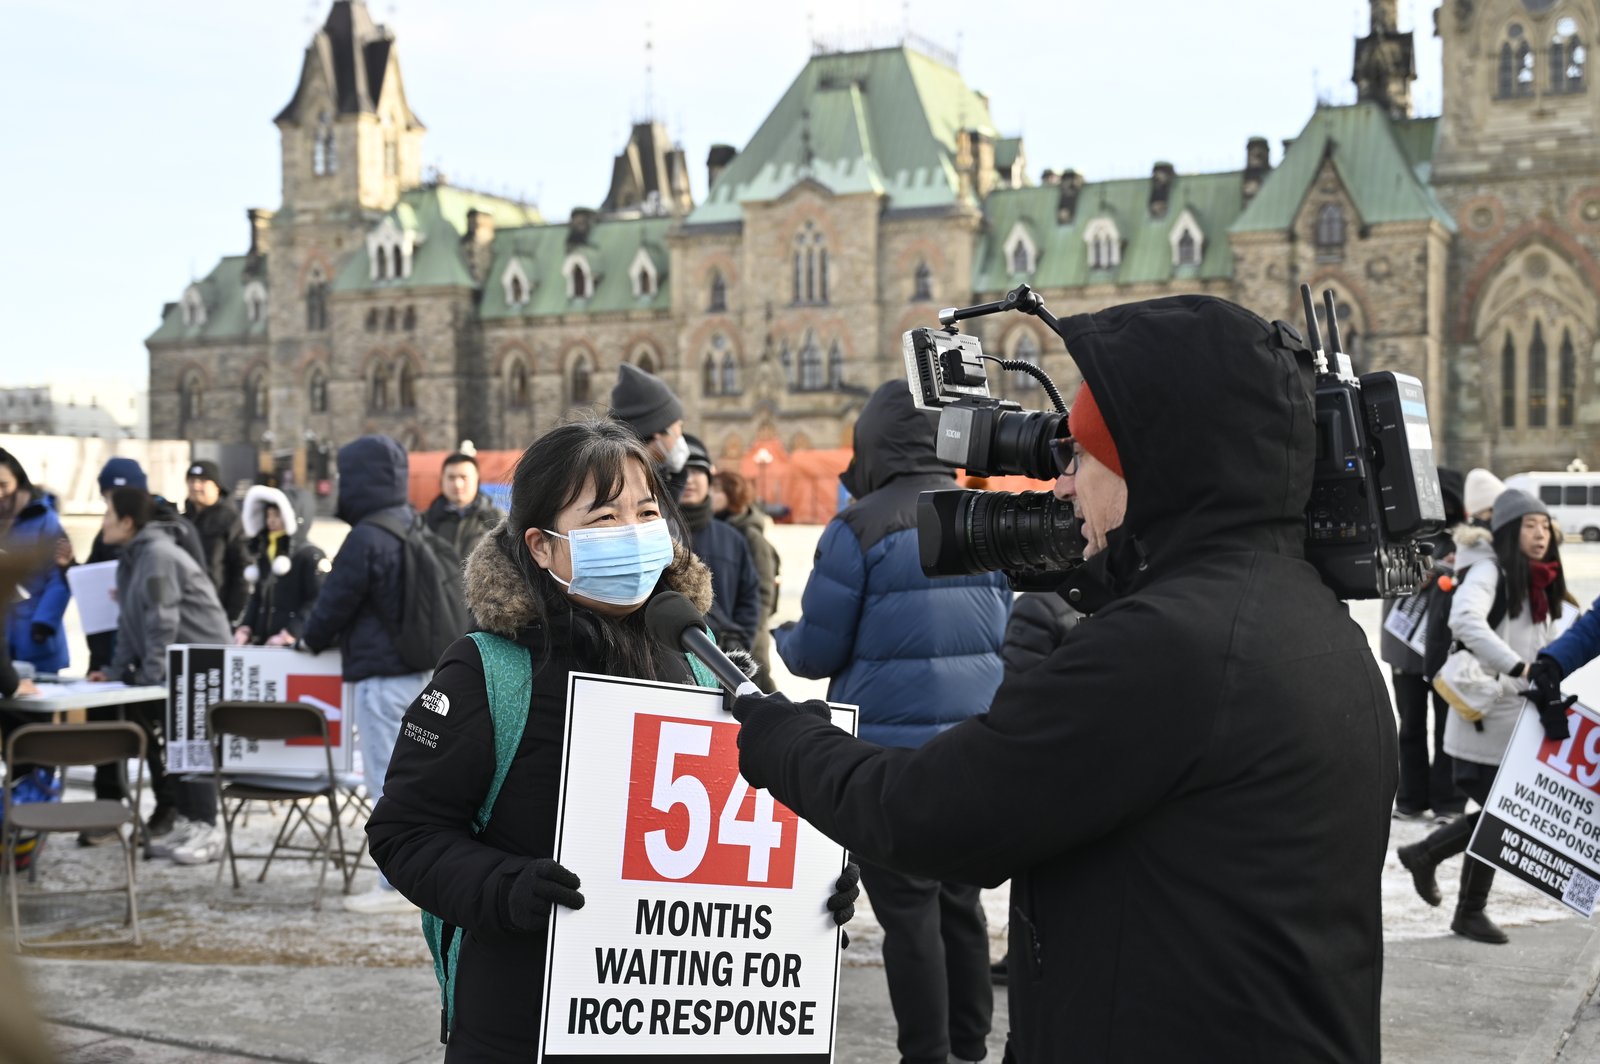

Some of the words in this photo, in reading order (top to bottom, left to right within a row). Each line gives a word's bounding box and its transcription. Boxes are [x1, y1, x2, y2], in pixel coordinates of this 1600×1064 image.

[231, 656, 243, 686] IRCC
[248, 664, 260, 702] WAIT
[421, 693, 440, 705] NORTH
[421, 700, 437, 712] FACE
[431, 689, 443, 700] THE
[230, 688, 243, 761] RNSE
[404, 728, 437, 749] EXPLORING
[406, 721, 423, 735] NEVER
[422, 729, 439, 741] STOP
[644, 721, 783, 883] 54
[1514, 782, 1571, 825] WAITING
[1573, 816, 1600, 843] FOR
[1534, 773, 1595, 815] MONTHS
[1497, 795, 1529, 823] IRCC
[1530, 810, 1600, 865] RESPONSE
[1500, 846, 1518, 866] NO
[1518, 855, 1568, 894] RESULTS
[1501, 828, 1520, 848] NO
[1520, 837, 1577, 878] TIMELINE
[635, 899, 772, 940] MONTHS
[595, 947, 733, 987] WAITING
[742, 951, 802, 988] FOR
[567, 997, 645, 1035] IRCC
[649, 998, 817, 1036] RESPONSE
